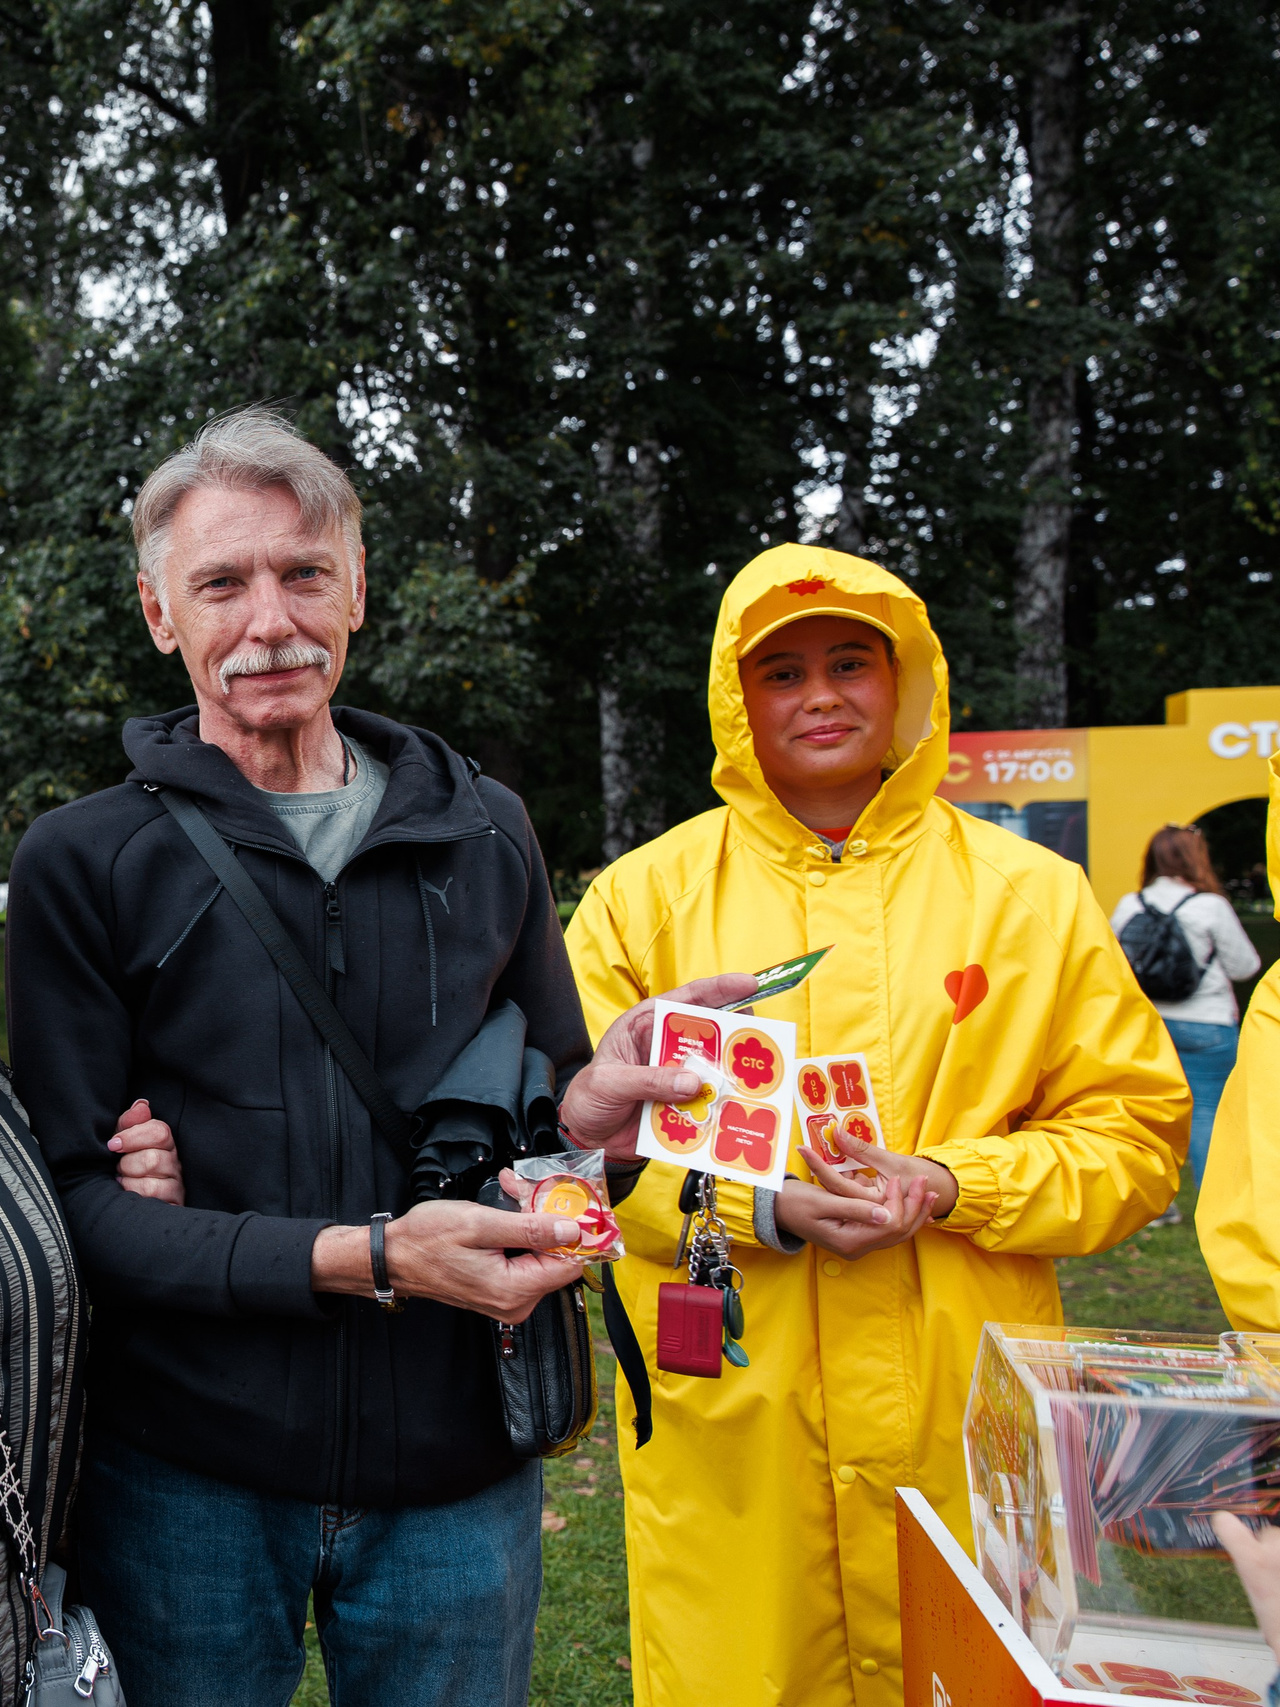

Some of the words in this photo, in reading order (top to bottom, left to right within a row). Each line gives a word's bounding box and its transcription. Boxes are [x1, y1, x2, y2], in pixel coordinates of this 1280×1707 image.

[1208, 721, 1280, 759] СТ
[984, 759, 1075, 783] 17:00
[677, 1036, 705, 1048] ВРЕМЯ
[741, 1056, 766, 1071] СТС
[726, 1124, 766, 1139] НАСТРОЕНИЕ
[735, 1137, 754, 1147] ЛЕТО!
